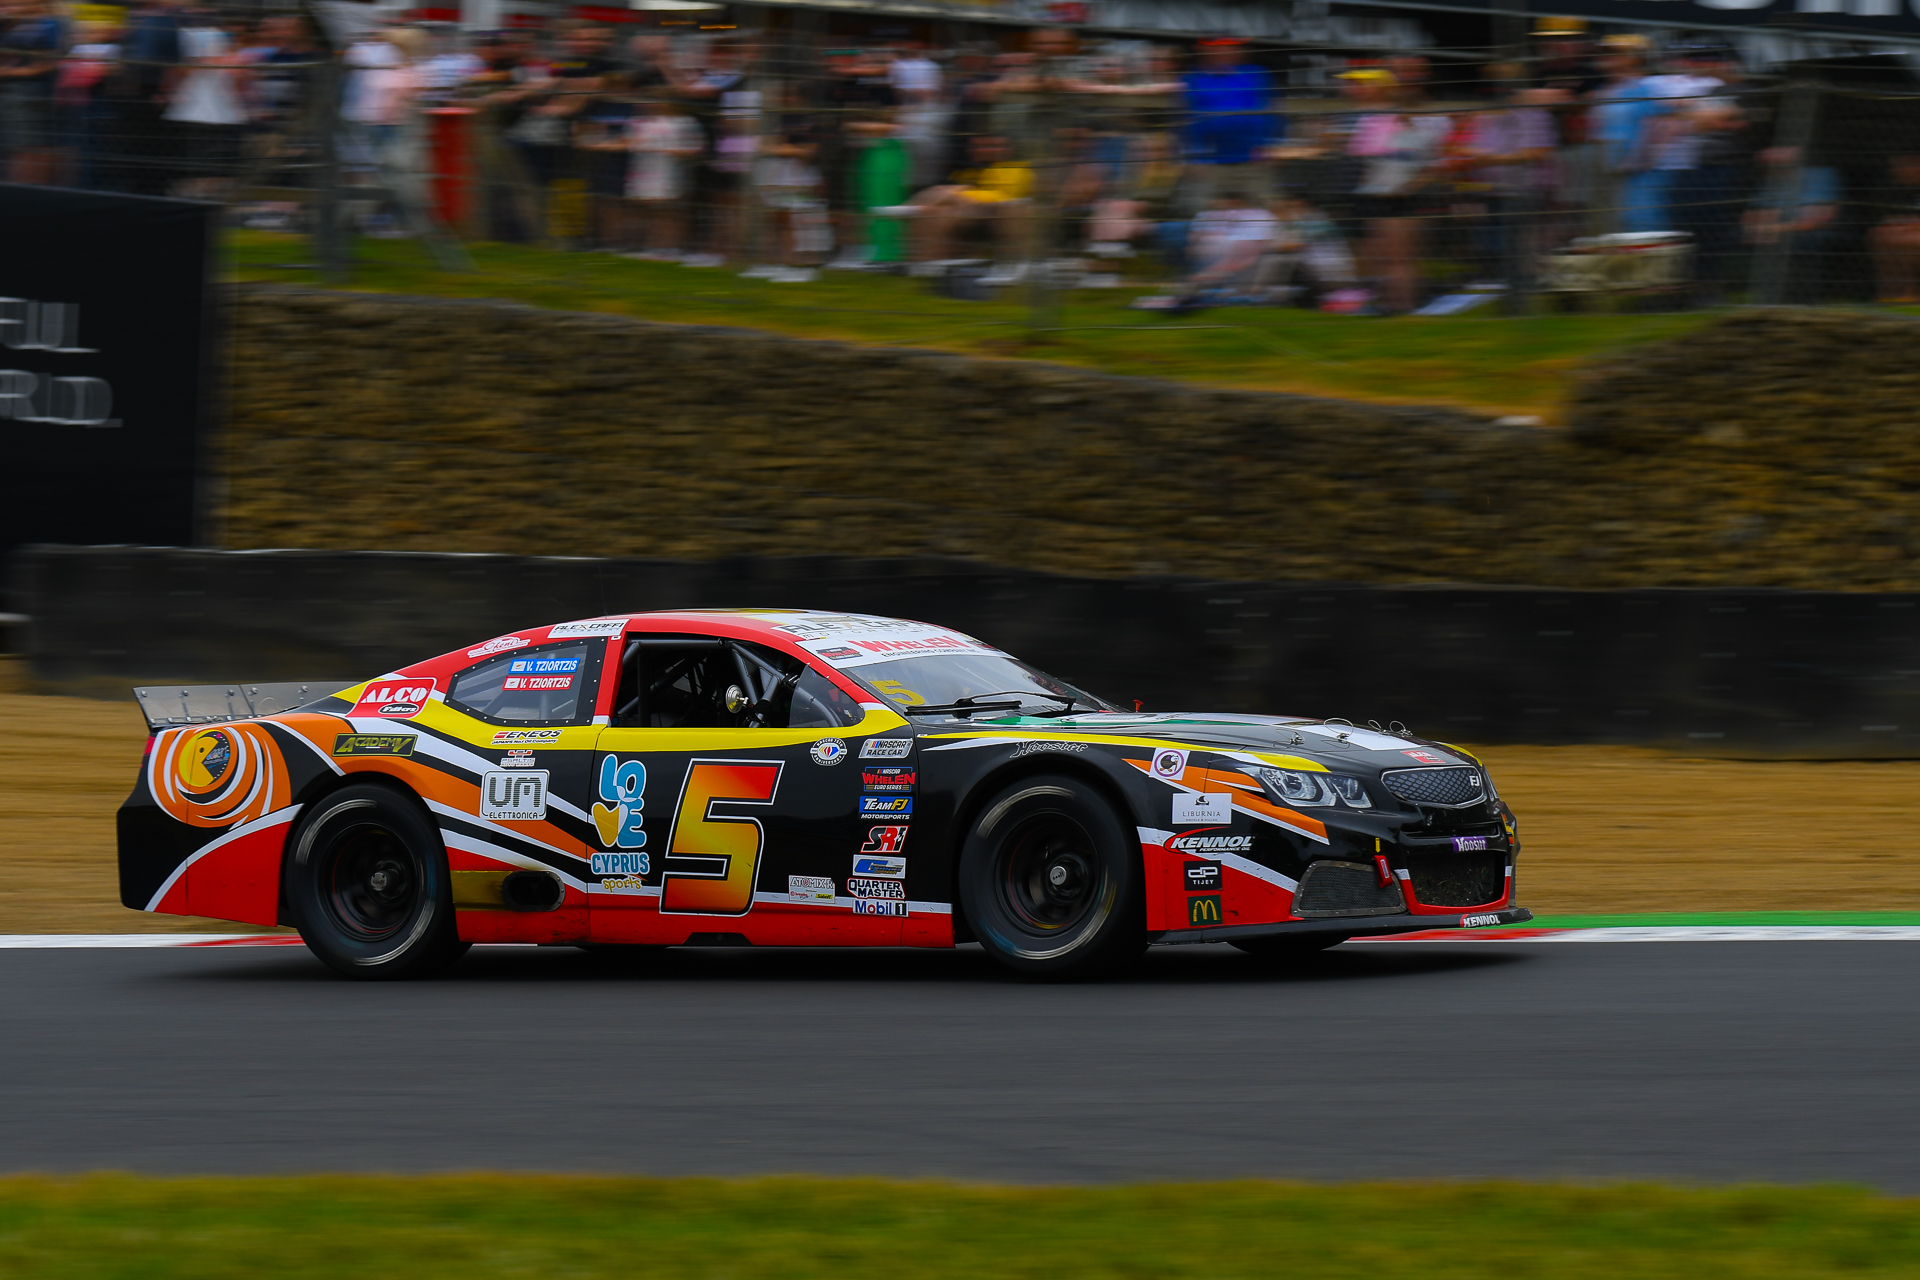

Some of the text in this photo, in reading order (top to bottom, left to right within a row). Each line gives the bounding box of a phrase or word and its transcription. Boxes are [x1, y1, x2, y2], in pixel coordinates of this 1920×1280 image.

[846, 636, 970, 653] WHELEN
[525, 660, 577, 671] V. TZIORTZIS
[519, 677, 571, 688] V. TZIORTZIS
[360, 687, 427, 703] ALCO
[869, 680, 925, 705] 5
[505, 730, 563, 738] ENEOS
[336, 737, 412, 752] ACADEMY
[862, 773, 915, 784] WHELEN
[660, 759, 784, 916] 5
[1170, 836, 1253, 849] KENNOL
[591, 853, 649, 874] CYPRUS
[603, 877, 641, 892] sports
[849, 880, 901, 891] QUARTER
[858, 888, 903, 898] MASTER
[855, 901, 907, 915] Mobil 1
[1463, 915, 1500, 927] KENNOL
